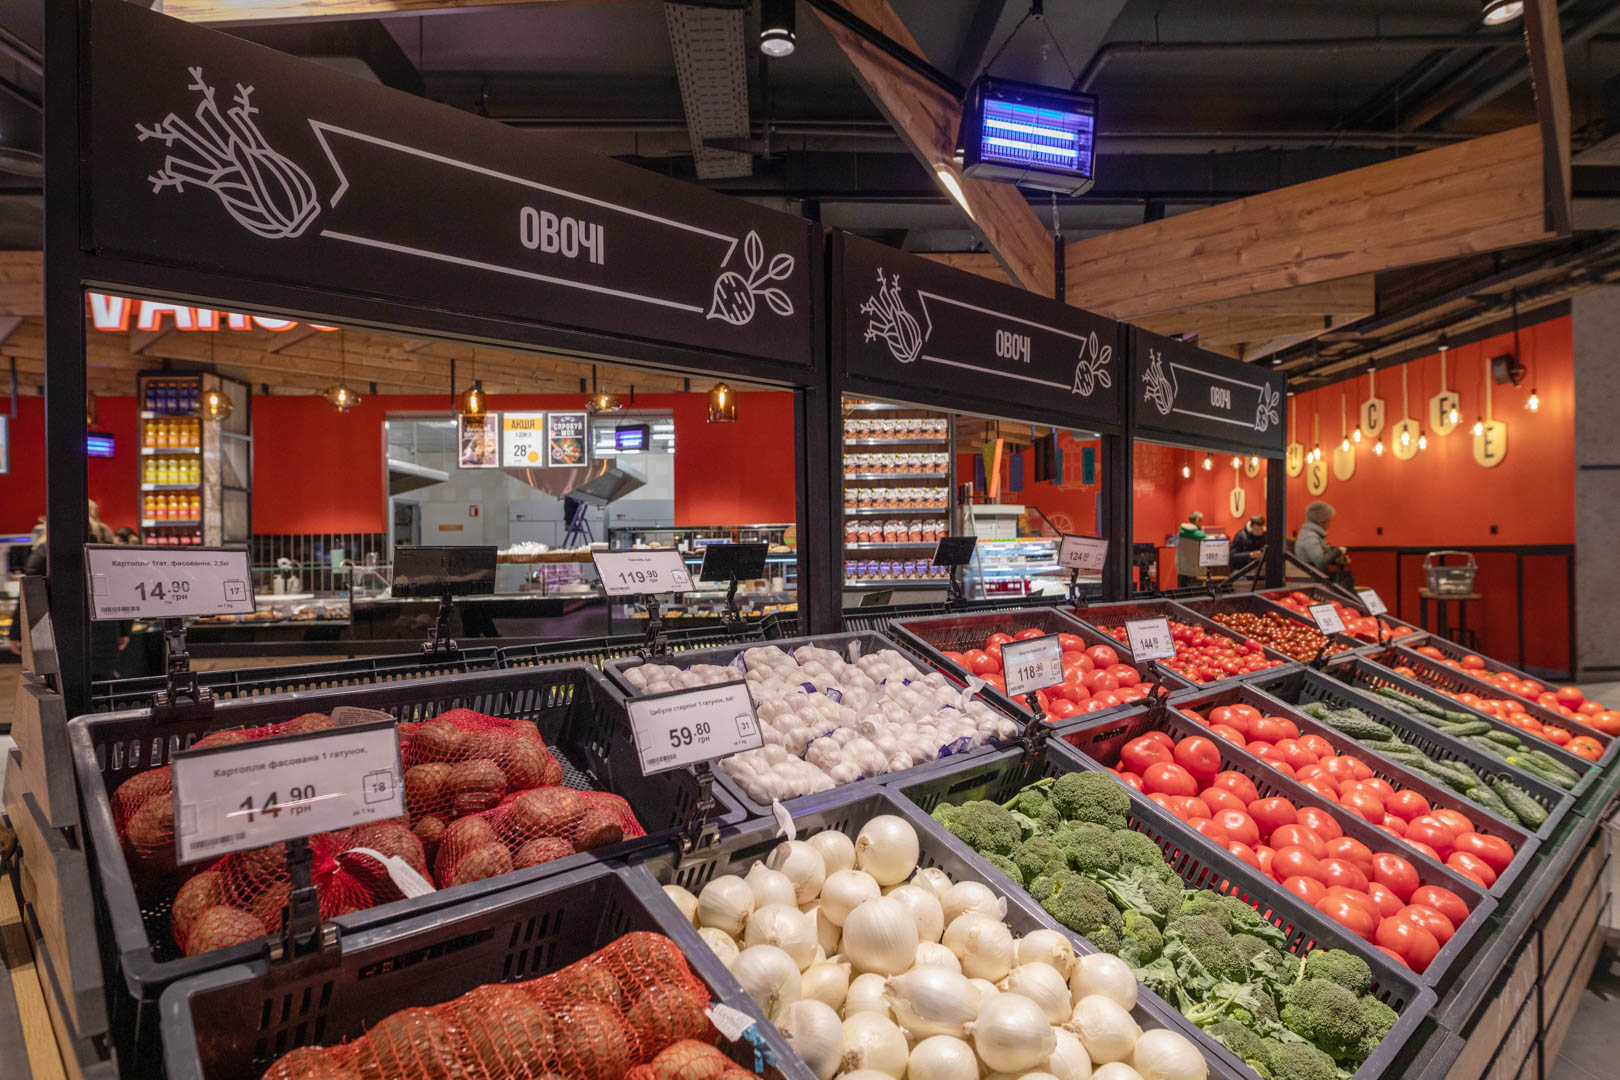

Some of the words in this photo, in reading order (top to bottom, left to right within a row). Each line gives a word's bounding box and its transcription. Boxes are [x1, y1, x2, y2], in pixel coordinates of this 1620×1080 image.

[520, 206, 604, 265] ОВОЧІ
[995, 329, 1031, 363] ОВОЧІ
[172, 593, 188, 601] грн
[229, 587, 240, 596] 17
[741, 721, 749, 730] 31
[214, 763, 266, 777] Картопля
[268, 755, 319, 769] фасована
[290, 804, 312, 817] грн
